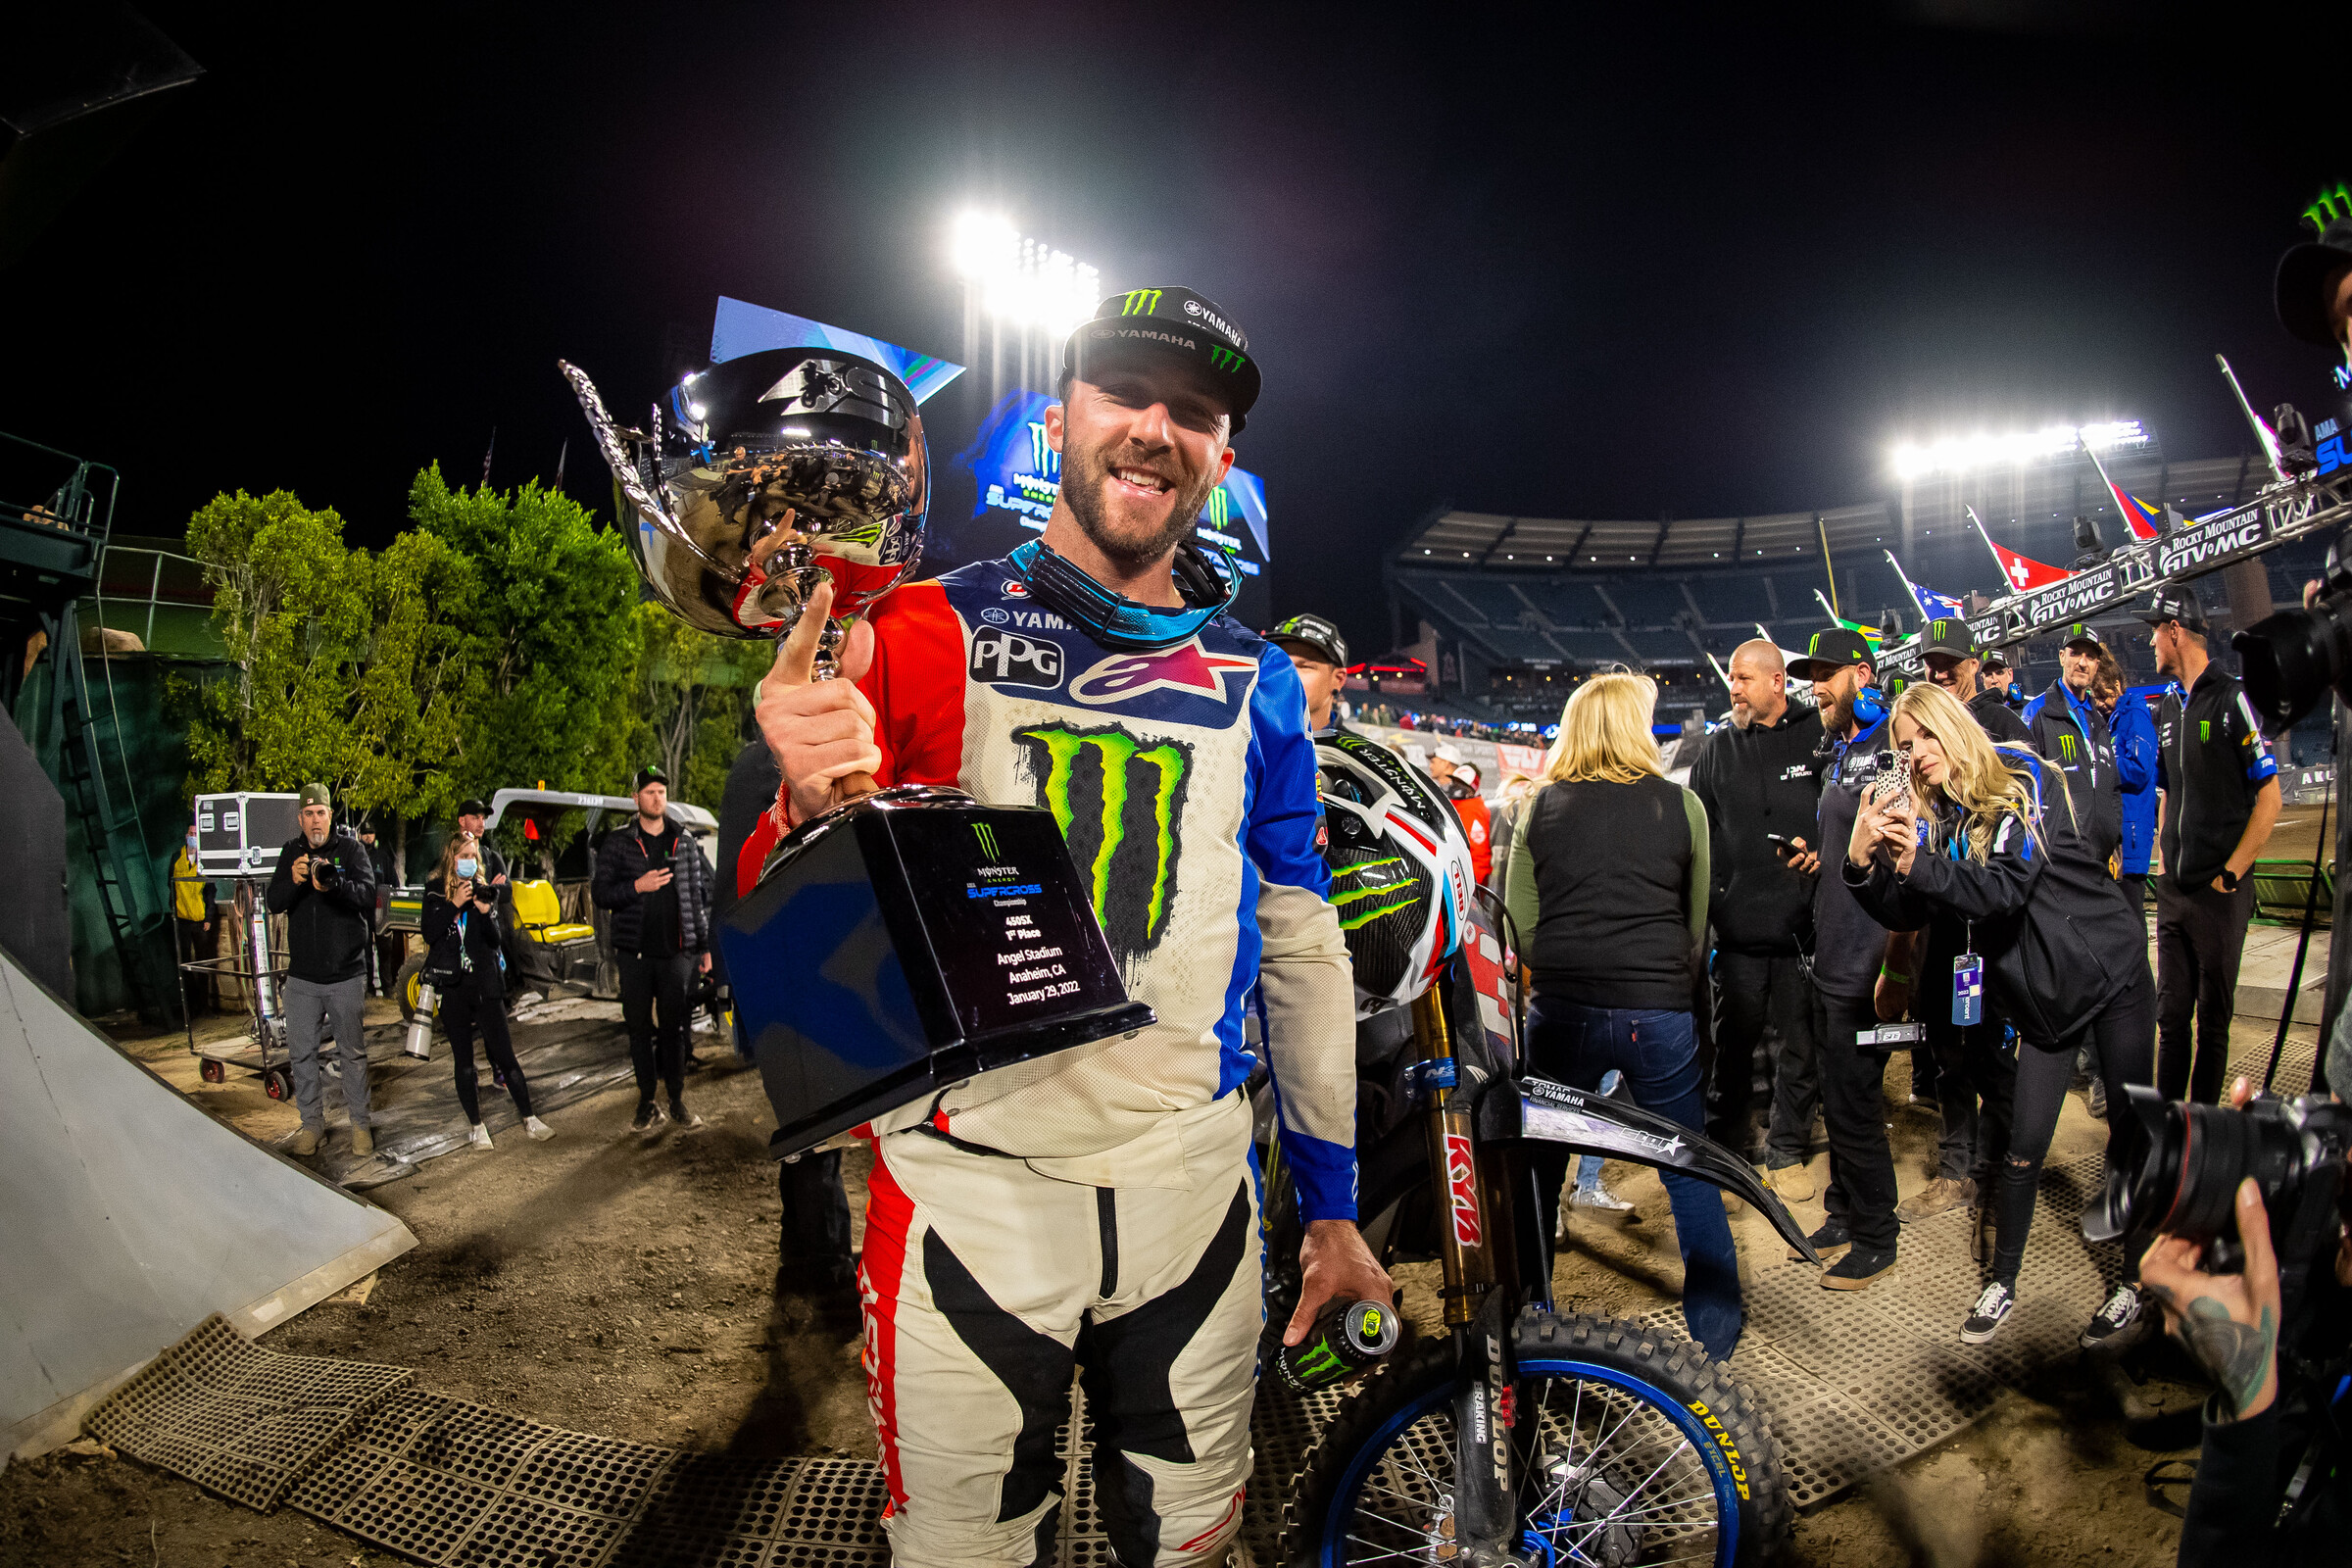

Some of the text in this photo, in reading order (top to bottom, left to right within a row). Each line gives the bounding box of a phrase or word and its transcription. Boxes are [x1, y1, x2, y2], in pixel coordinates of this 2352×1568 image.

[1117, 329, 1197, 351] YAMAHA
[1202, 307, 1242, 348] YAMAHA
[2314, 417, 2339, 442] AMA
[2316, 434, 2352, 476] SU
[2172, 509, 2259, 553] ROCKY MOUNTAIN
[2040, 568, 2113, 606] ROCKY MOUNTAIN
[1011, 610, 1080, 633] YAM
[1967, 616, 1999, 632] OUNTAIN
[973, 633, 1058, 678] PPG
[1886, 647, 1917, 667] MOUNTAIN
[1359, 749, 1427, 809] MONSTER
[977, 866, 1020, 876] MONSTER
[966, 884, 1043, 899] SUPERCROSS
[1454, 867, 1464, 913] BELL
[1005, 914, 1034, 926] 450SX
[1017, 928, 1042, 940] Place
[997, 946, 1063, 966] Angel Stadium
[1008, 963, 1067, 984] Anaheim, CA
[1006, 980, 1081, 1005] January 29, 2022
[1529, 1097, 1581, 1115] FINANCIAL SERVICES
[1544, 1090, 1585, 1107] YAMAHA
[1443, 1133, 1482, 1249] KYB
[1473, 1381, 1488, 1445] BRAKING
[1486, 1334, 1509, 1493] DUNLOP
[1687, 1399, 1750, 1500] DUNLOP
[1703, 1441, 1726, 1478] EXCEL
